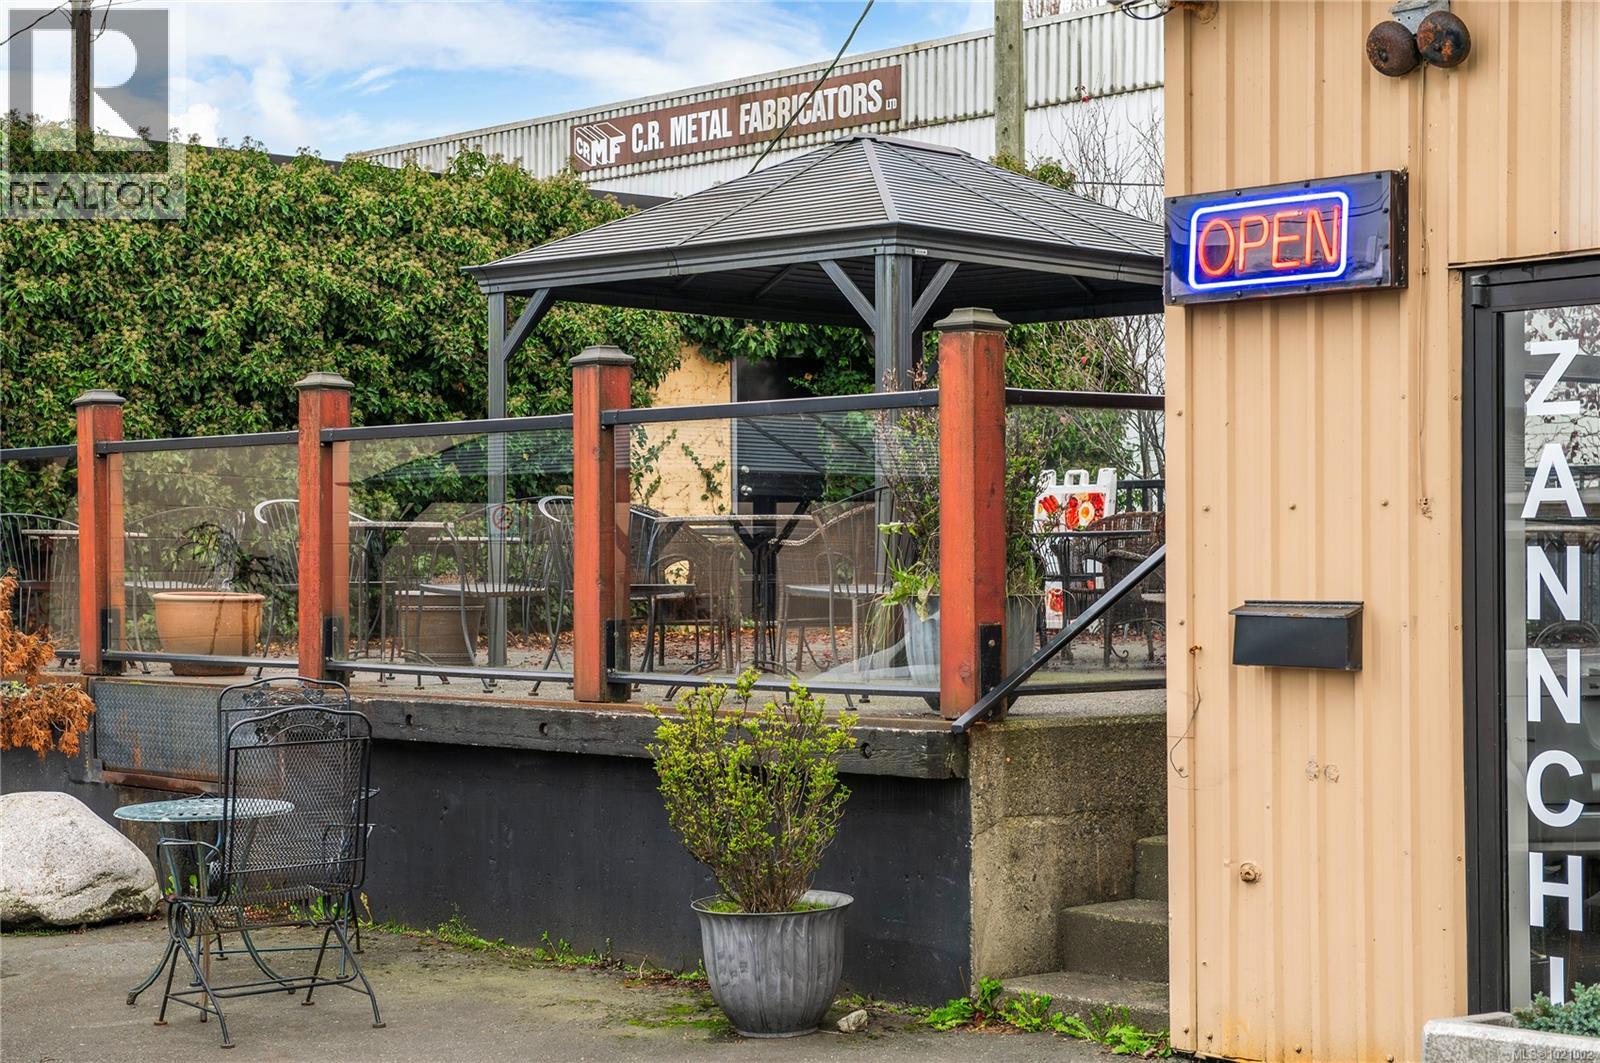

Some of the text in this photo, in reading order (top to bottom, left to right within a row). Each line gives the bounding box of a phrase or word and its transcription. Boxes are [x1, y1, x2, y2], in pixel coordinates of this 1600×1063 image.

[632, 121, 665, 154] C.R.
[670, 107, 733, 147] METAL
[739, 79, 883, 136] FABRICATORS
[1198, 204, 1341, 277] OPEN
[1520, 339, 1587, 1007] ZANNCHI
